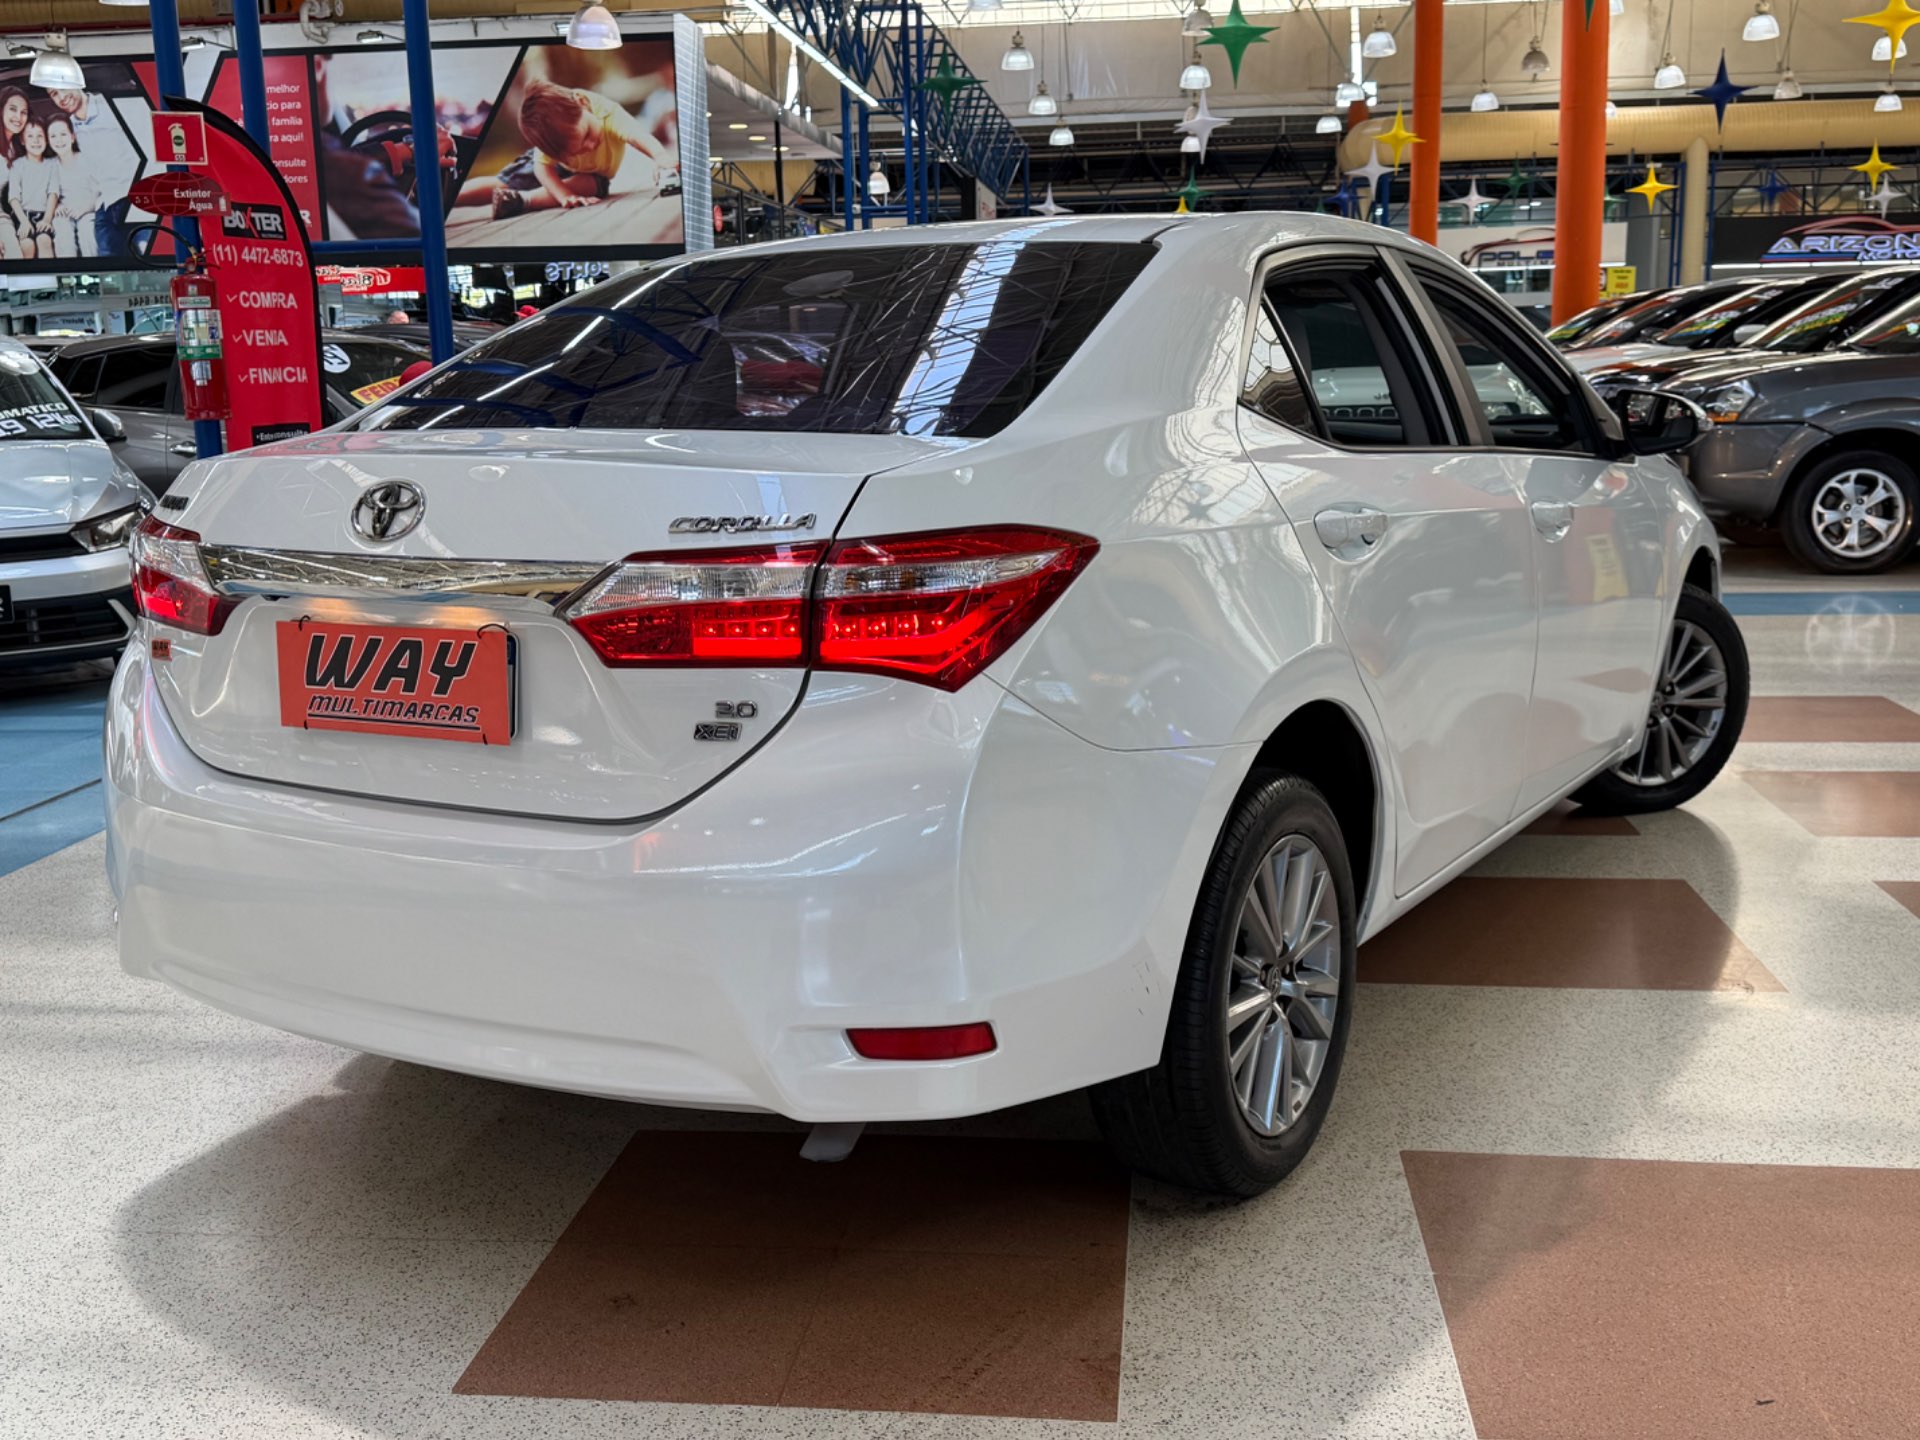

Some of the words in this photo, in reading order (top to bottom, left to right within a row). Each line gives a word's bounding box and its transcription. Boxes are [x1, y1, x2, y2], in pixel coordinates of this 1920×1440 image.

[281, 102, 301, 111] para
[173, 188, 212, 198] Extintor
[223, 207, 284, 237] BOXTER
[213, 243, 238, 266] (11)
[241, 246, 304, 267] 4472-6873
[239, 290, 298, 309] COMPRA
[668, 513, 817, 534] COROLLA
[304, 633, 479, 698] WAY
[307, 694, 480, 723] MULTIMARCAS
